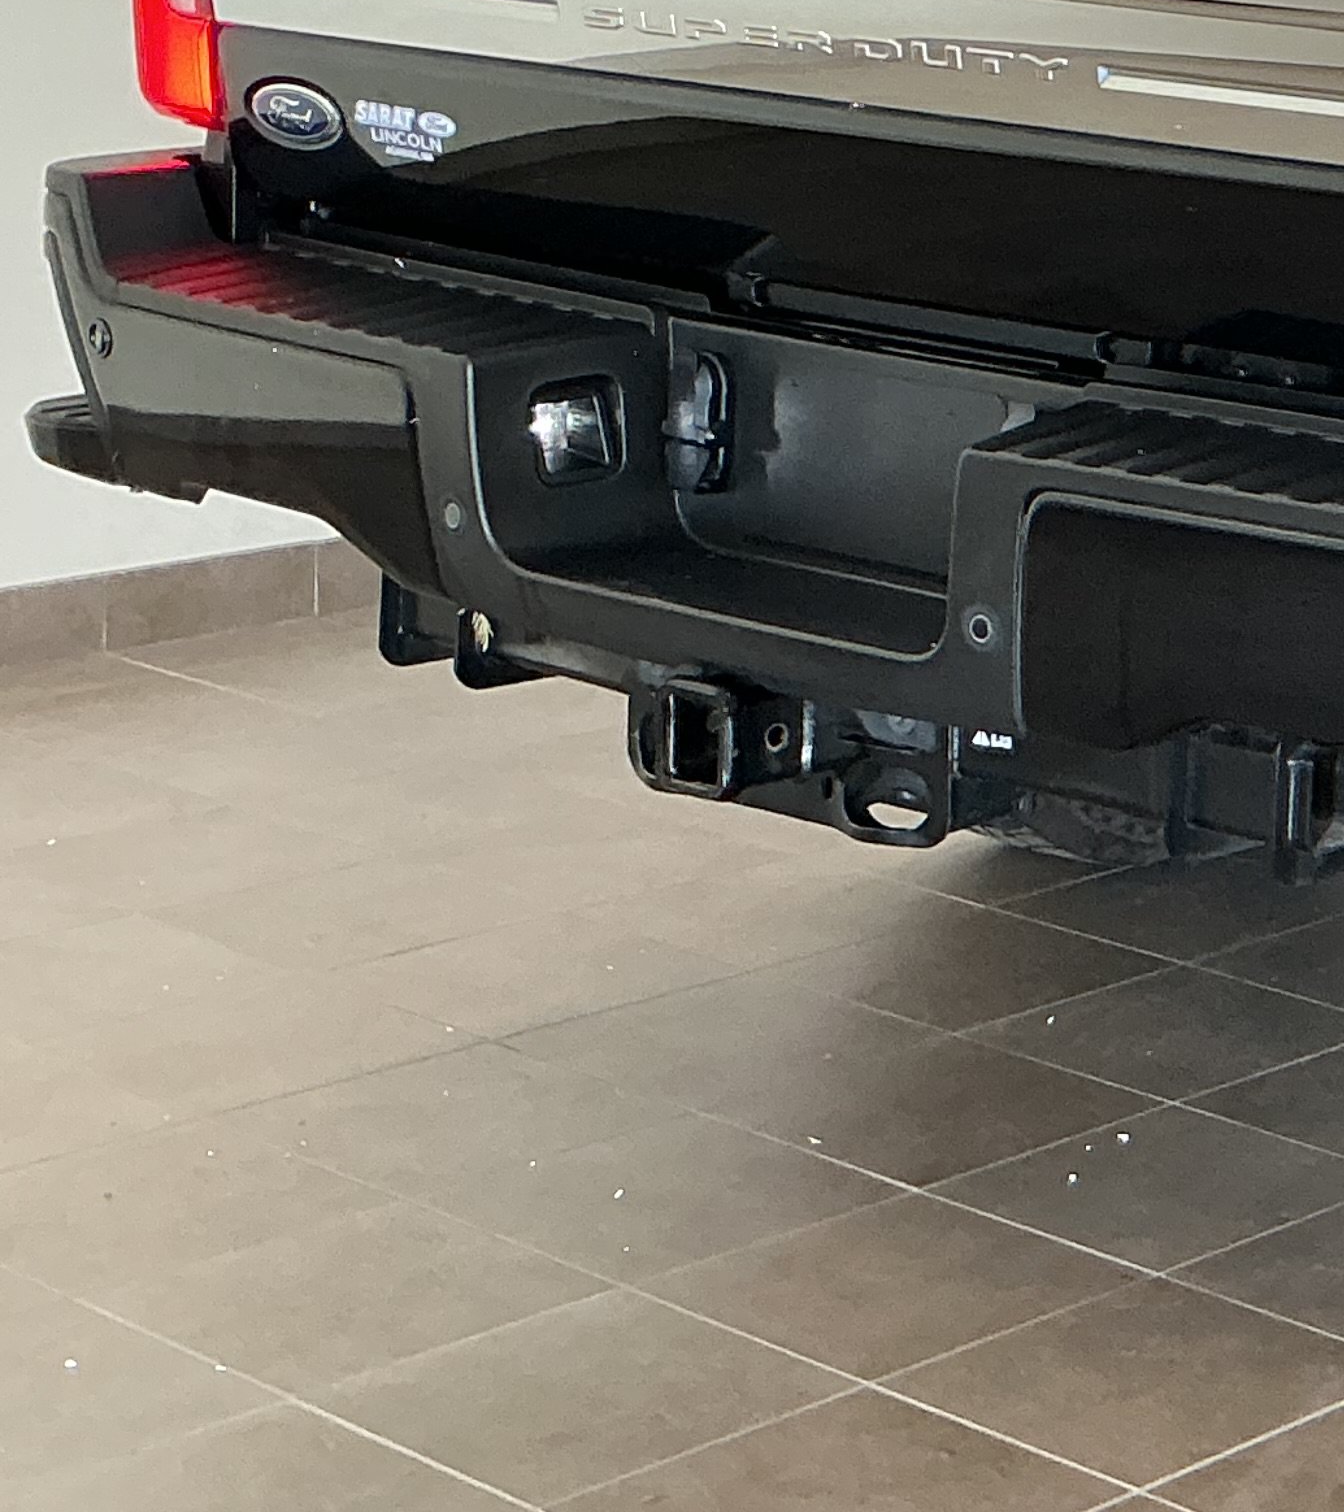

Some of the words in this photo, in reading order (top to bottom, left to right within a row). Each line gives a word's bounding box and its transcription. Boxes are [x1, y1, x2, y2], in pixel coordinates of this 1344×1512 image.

[583, 6, 834, 55] SUPER
[853, 38, 1069, 80] DUTY
[354, 99, 416, 131] SARAT
[370, 127, 443, 153] LINCOLN
